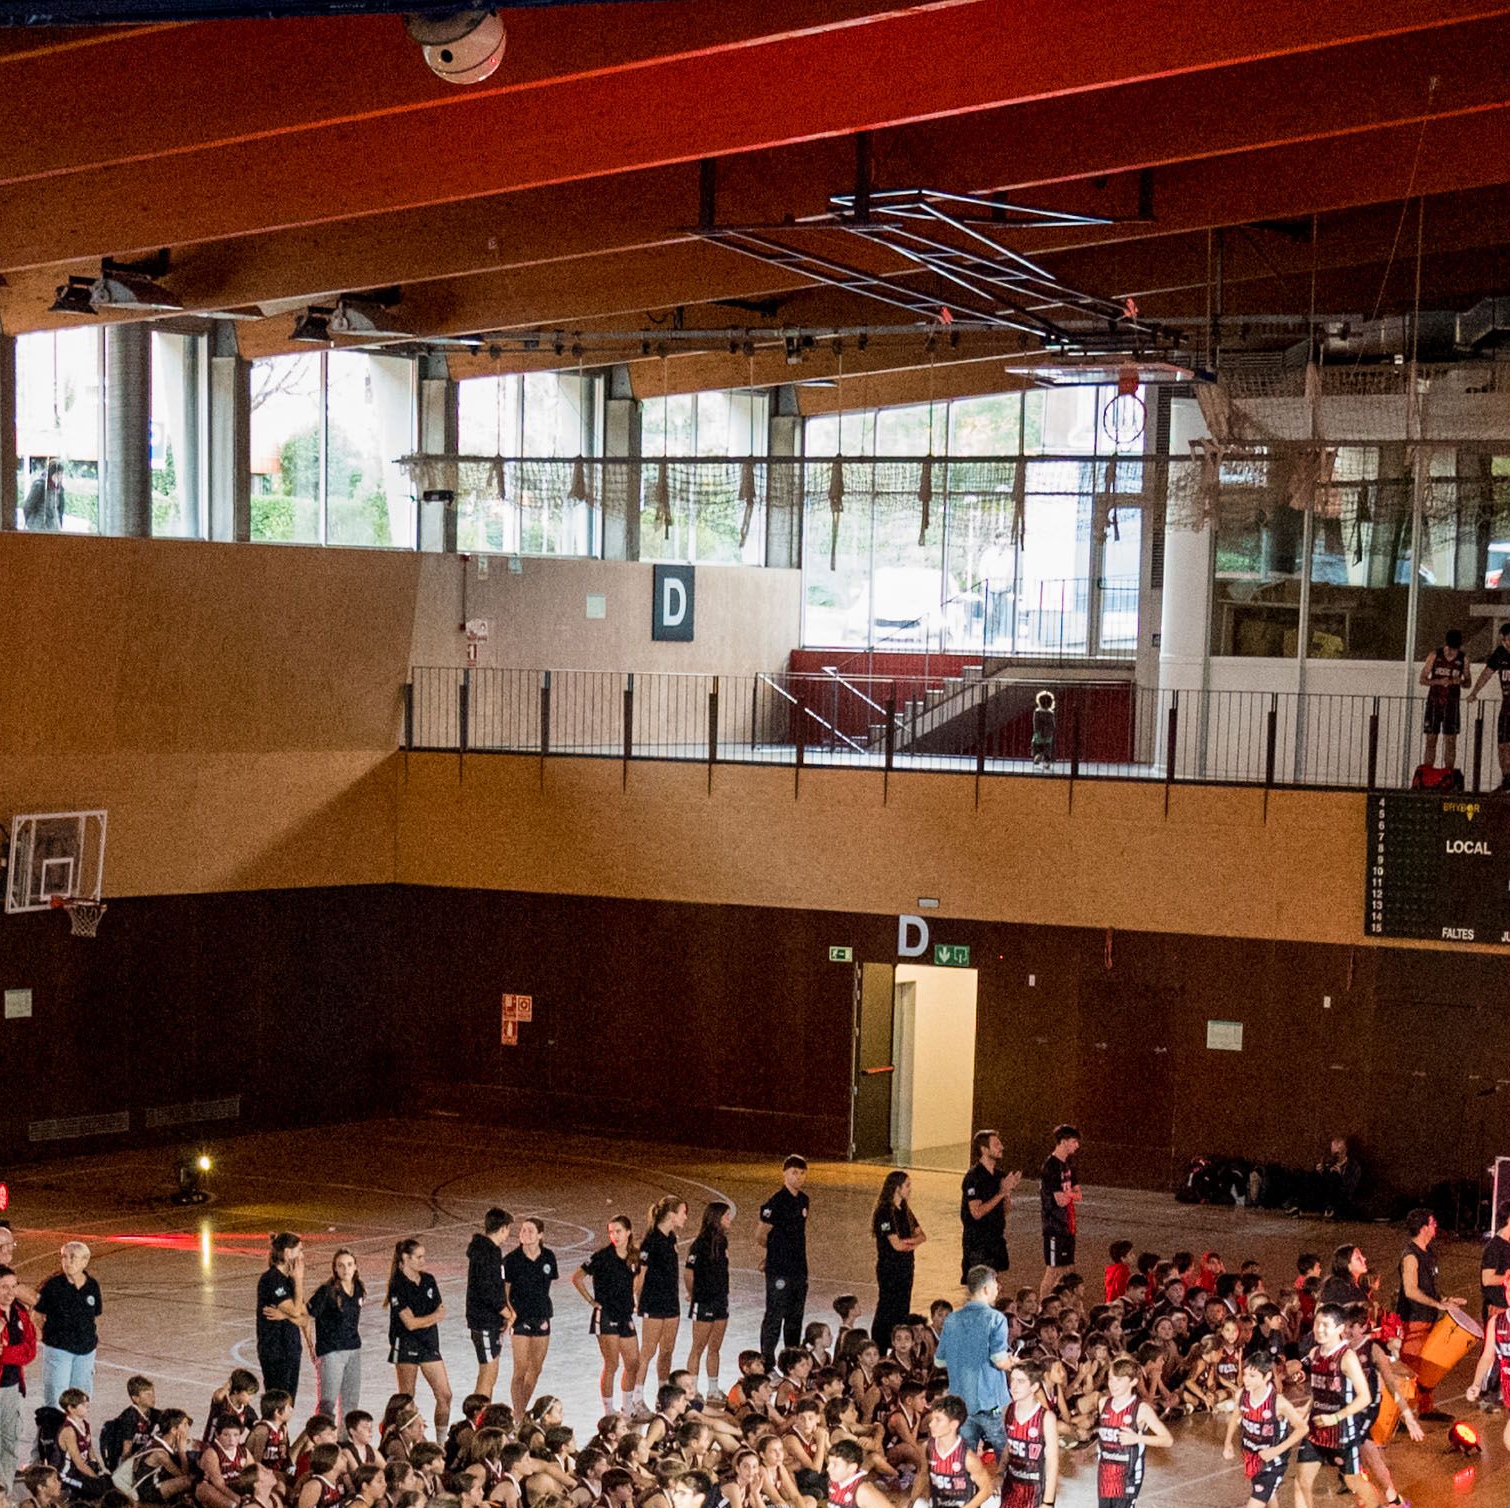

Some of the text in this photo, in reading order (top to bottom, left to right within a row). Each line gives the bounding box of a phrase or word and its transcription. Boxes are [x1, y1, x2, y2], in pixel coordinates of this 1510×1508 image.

[662, 577, 687, 627] D
[1378, 798, 1385, 807] 4
[1378, 821, 1385, 830] 6
[1378, 832, 1384, 841] 7
[1446, 839, 1492, 855] LOCAL
[1372, 866, 1383, 876] 10
[1372, 878, 1382, 887] 11
[1372, 889, 1383, 898] 12
[1372, 900, 1383, 910] 13
[1371, 912, 1382, 921] 14
[898, 914, 929, 957] D
[1442, 927, 1475, 941] FALTES
